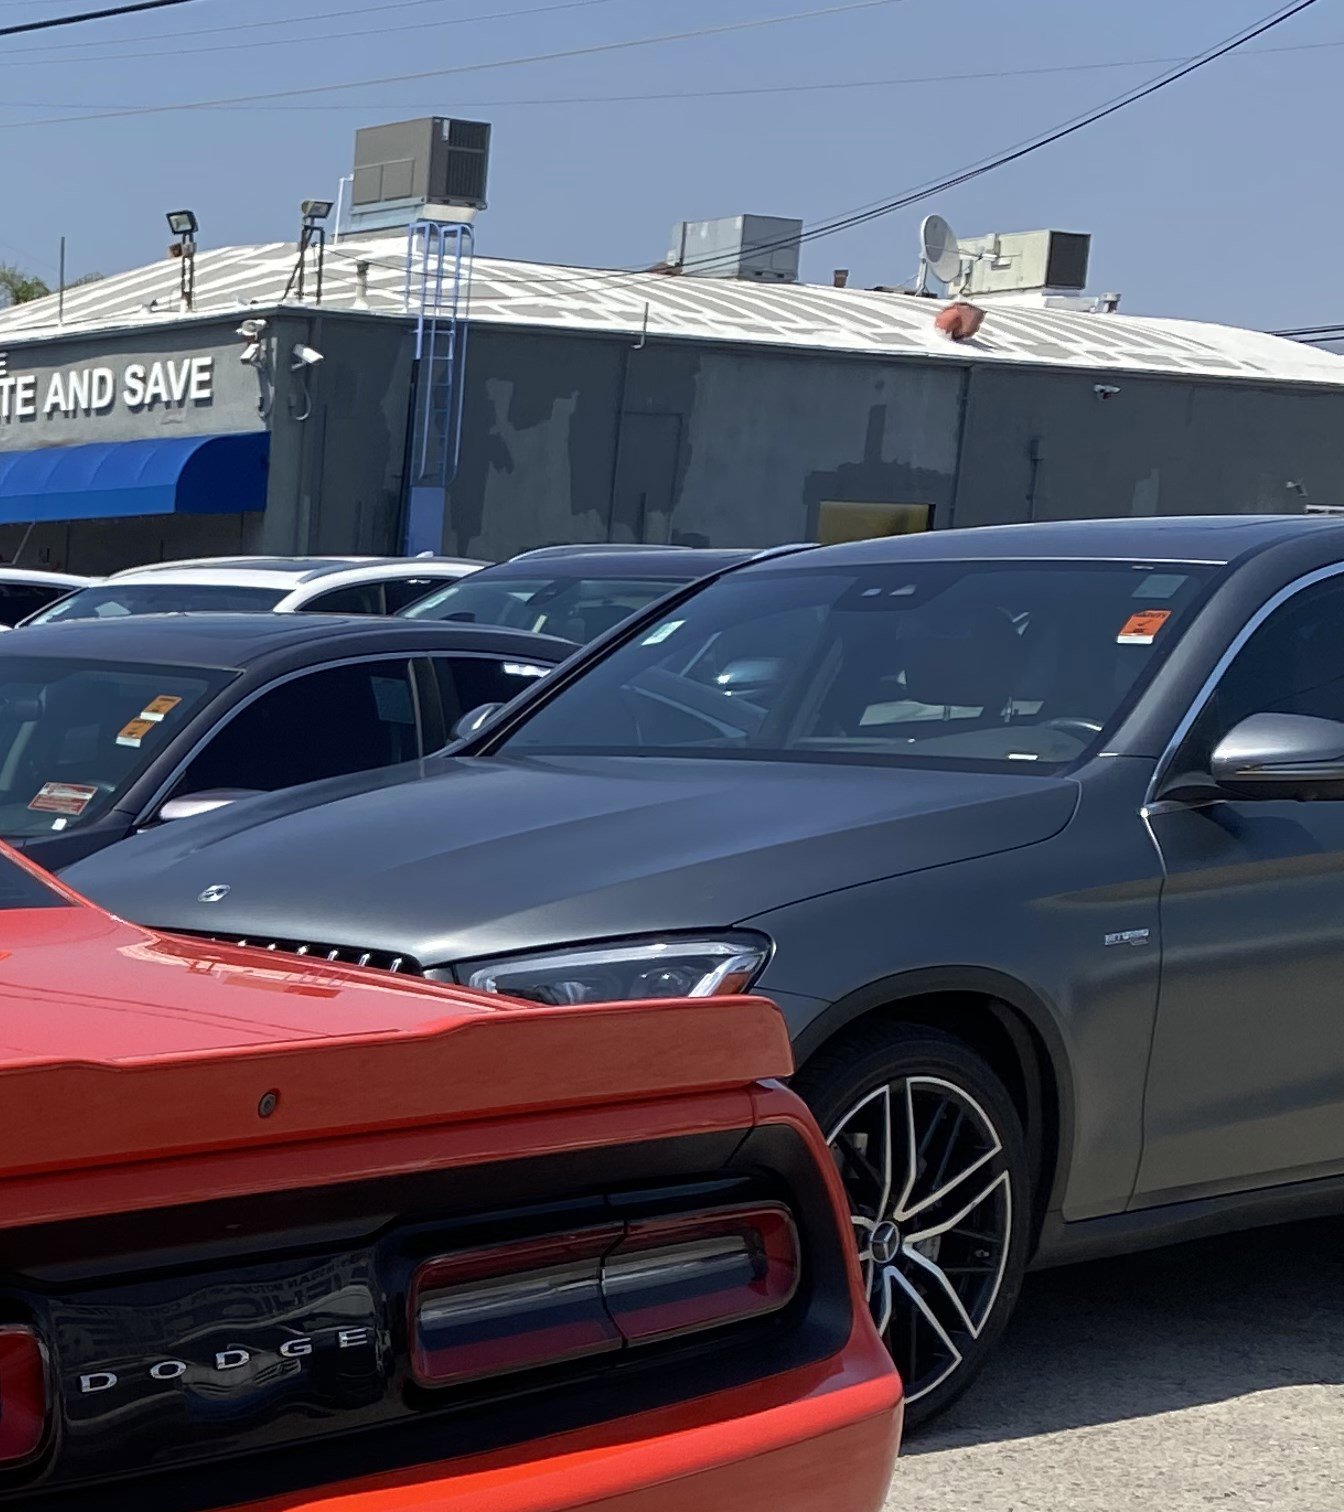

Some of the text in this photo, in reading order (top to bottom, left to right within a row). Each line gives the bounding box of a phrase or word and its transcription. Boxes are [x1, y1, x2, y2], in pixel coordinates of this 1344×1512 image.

[42, 367, 114, 413] AND
[122, 356, 213, 407] SAVE
[79, 1328, 369, 1394] DODGE
